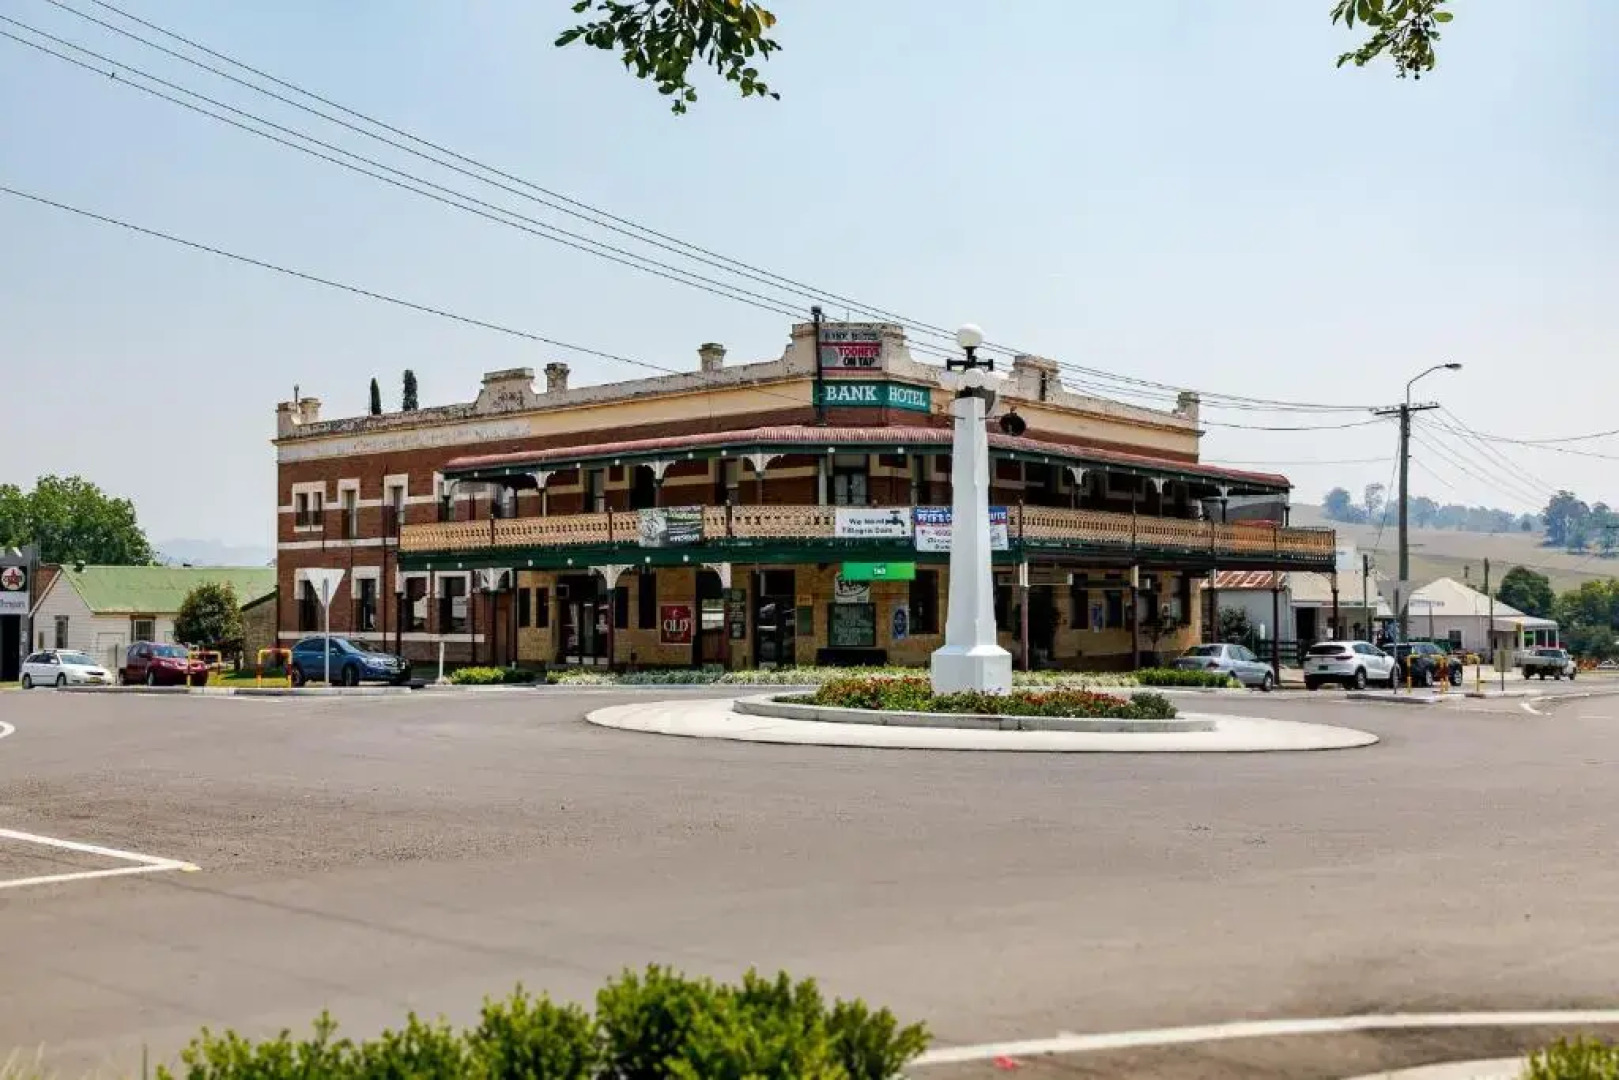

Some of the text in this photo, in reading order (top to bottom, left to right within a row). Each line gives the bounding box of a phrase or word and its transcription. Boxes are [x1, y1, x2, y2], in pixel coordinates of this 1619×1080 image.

[838, 347, 880, 357] TOOHEYS
[843, 357, 875, 366] ON TAP
[826, 385, 926, 407] BANK HOTEL
[663, 619, 689, 632] OLD
